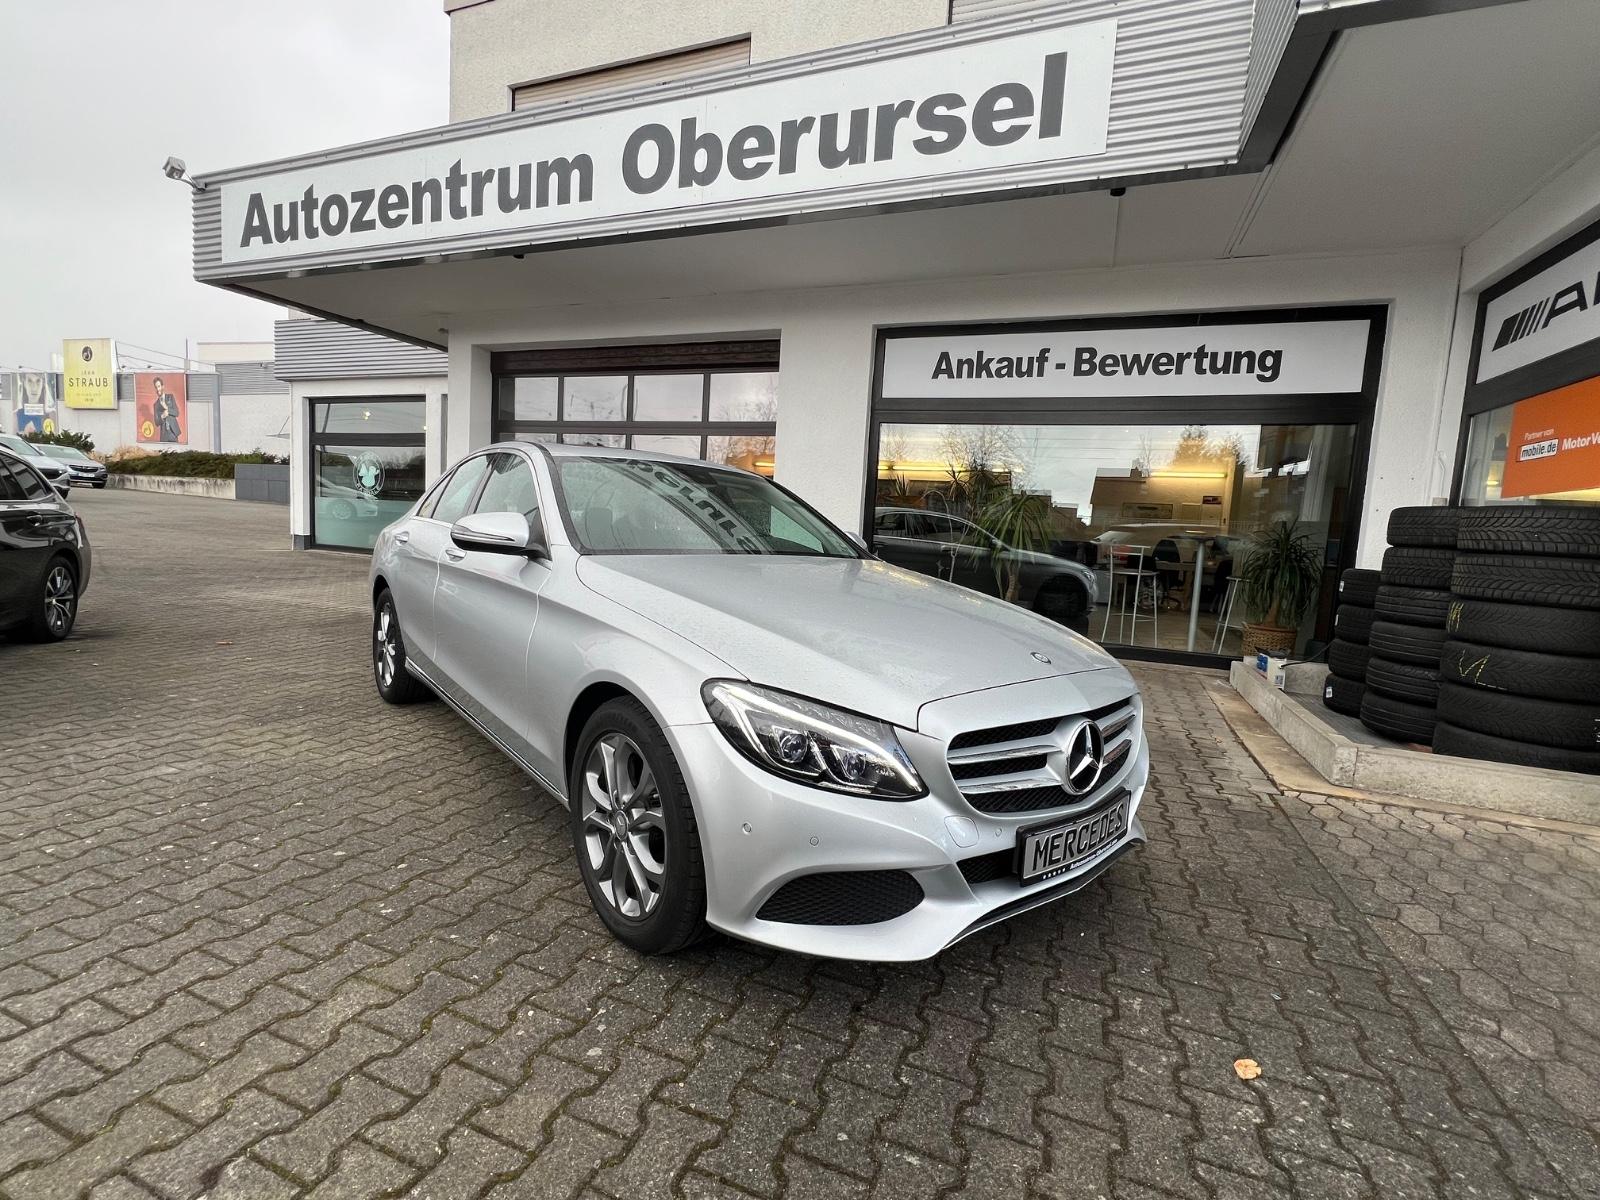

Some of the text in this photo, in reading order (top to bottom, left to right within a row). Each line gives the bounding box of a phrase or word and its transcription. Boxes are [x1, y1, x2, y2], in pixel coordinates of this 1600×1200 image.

[240, 51, 1068, 249] Autozentrum Oberursel
[1541, 271, 1600, 329] A
[68, 377, 108, 387] STRAUB
[931, 347, 1051, 380] Ankauf
[1073, 344, 1283, 383] Bewertung
[1521, 442, 1557, 457] mobile.de
[1032, 801, 1124, 871] MERCEDES
